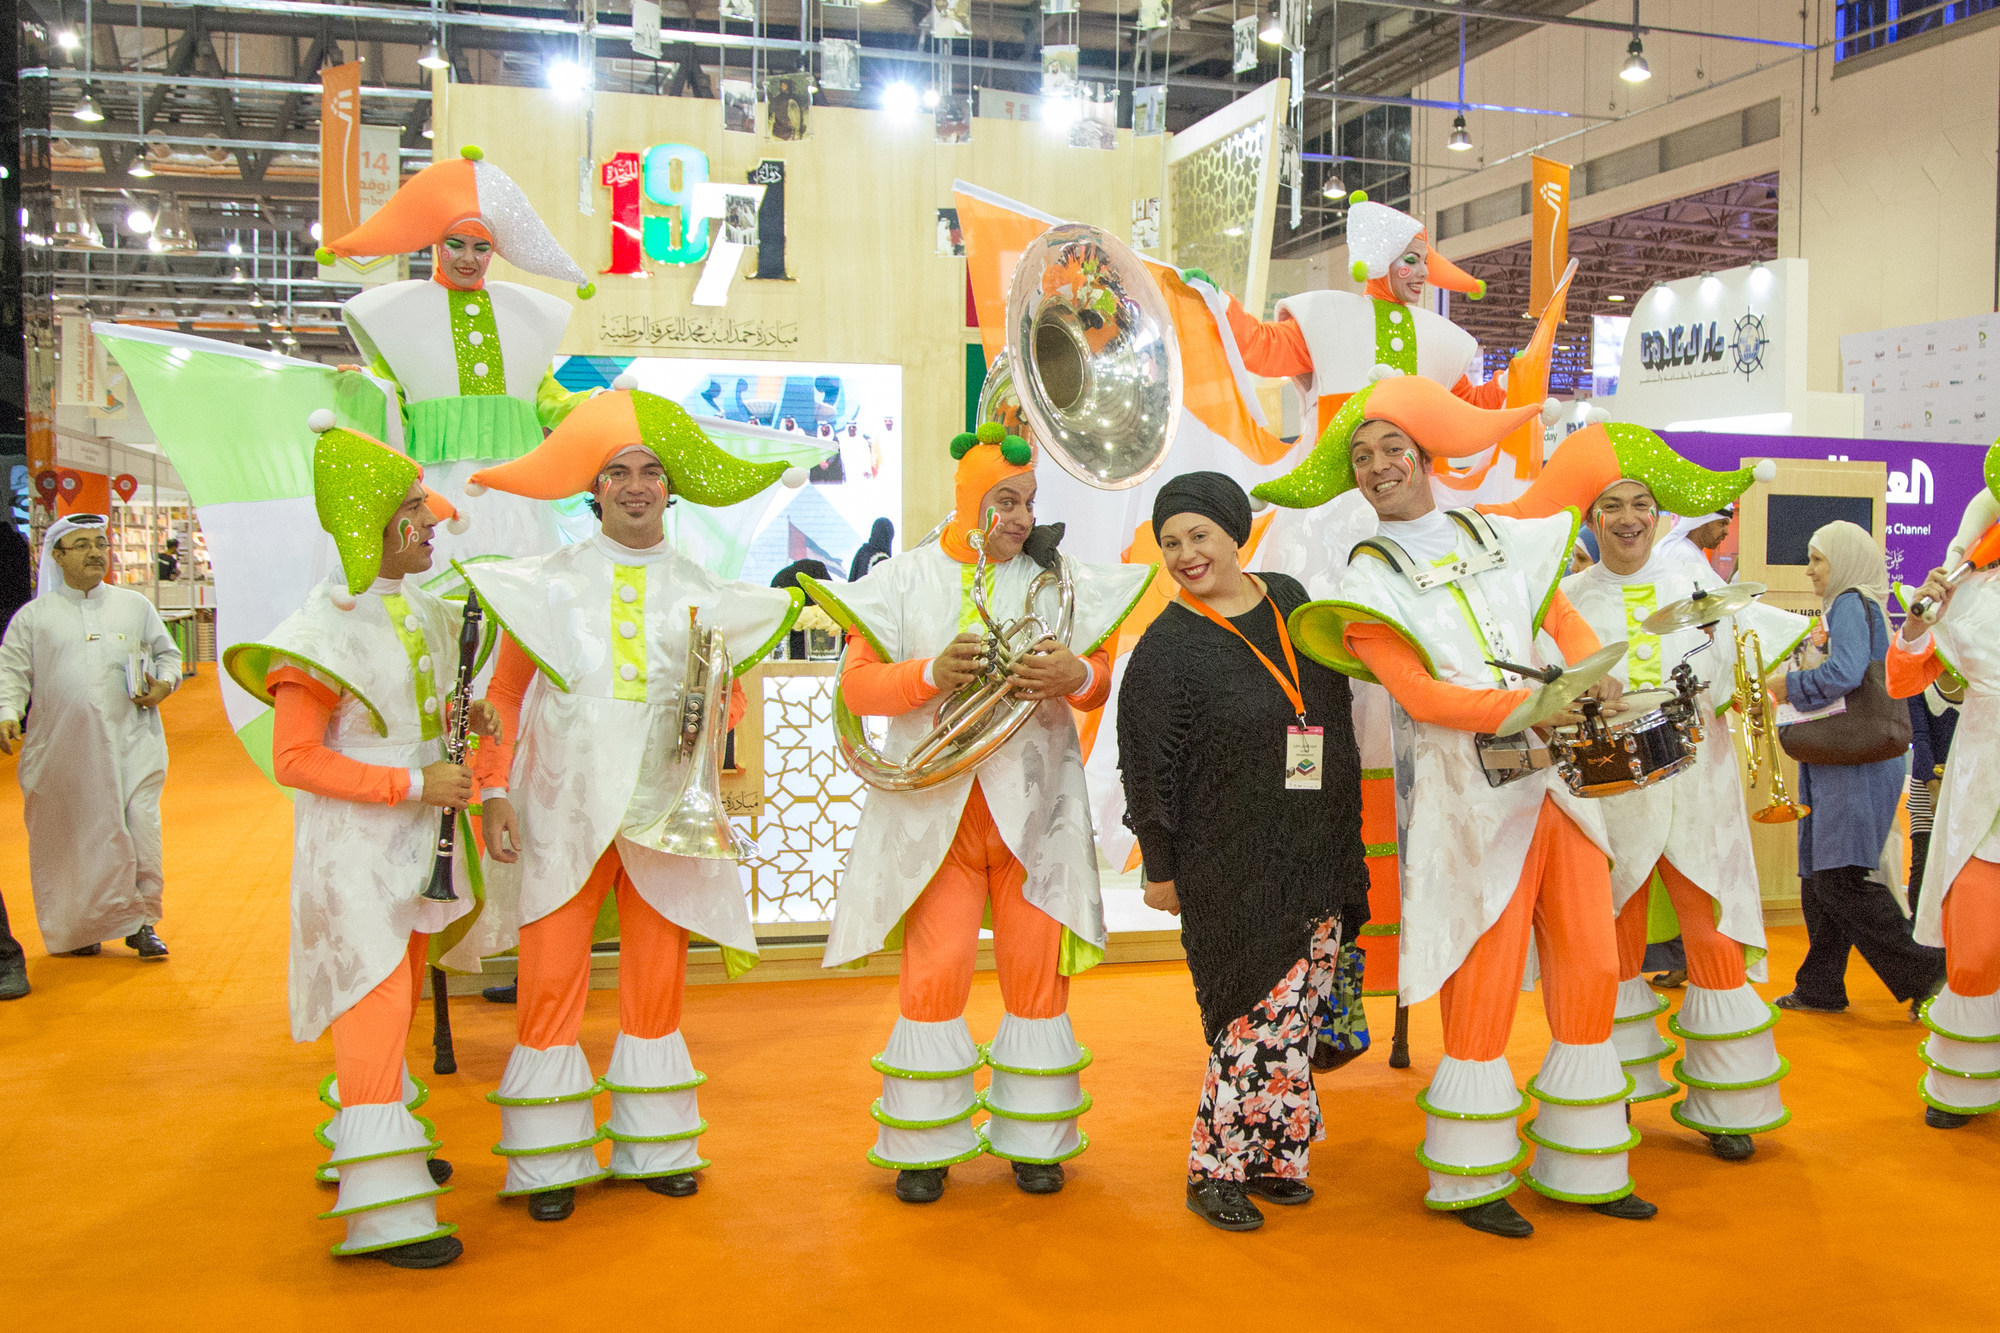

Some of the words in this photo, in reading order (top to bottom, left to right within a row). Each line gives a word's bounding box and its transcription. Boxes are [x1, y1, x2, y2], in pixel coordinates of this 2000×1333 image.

[362, 151, 390, 175] 14
[359, 180, 390, 194] نوفم
[599, 143, 798, 306] 1971
[1641, 323, 1703, 369] الخليج
[1702, 321, 1724, 361] دار
[1544, 432, 1557, 443] day
[1893, 523, 1931, 535] Channel
